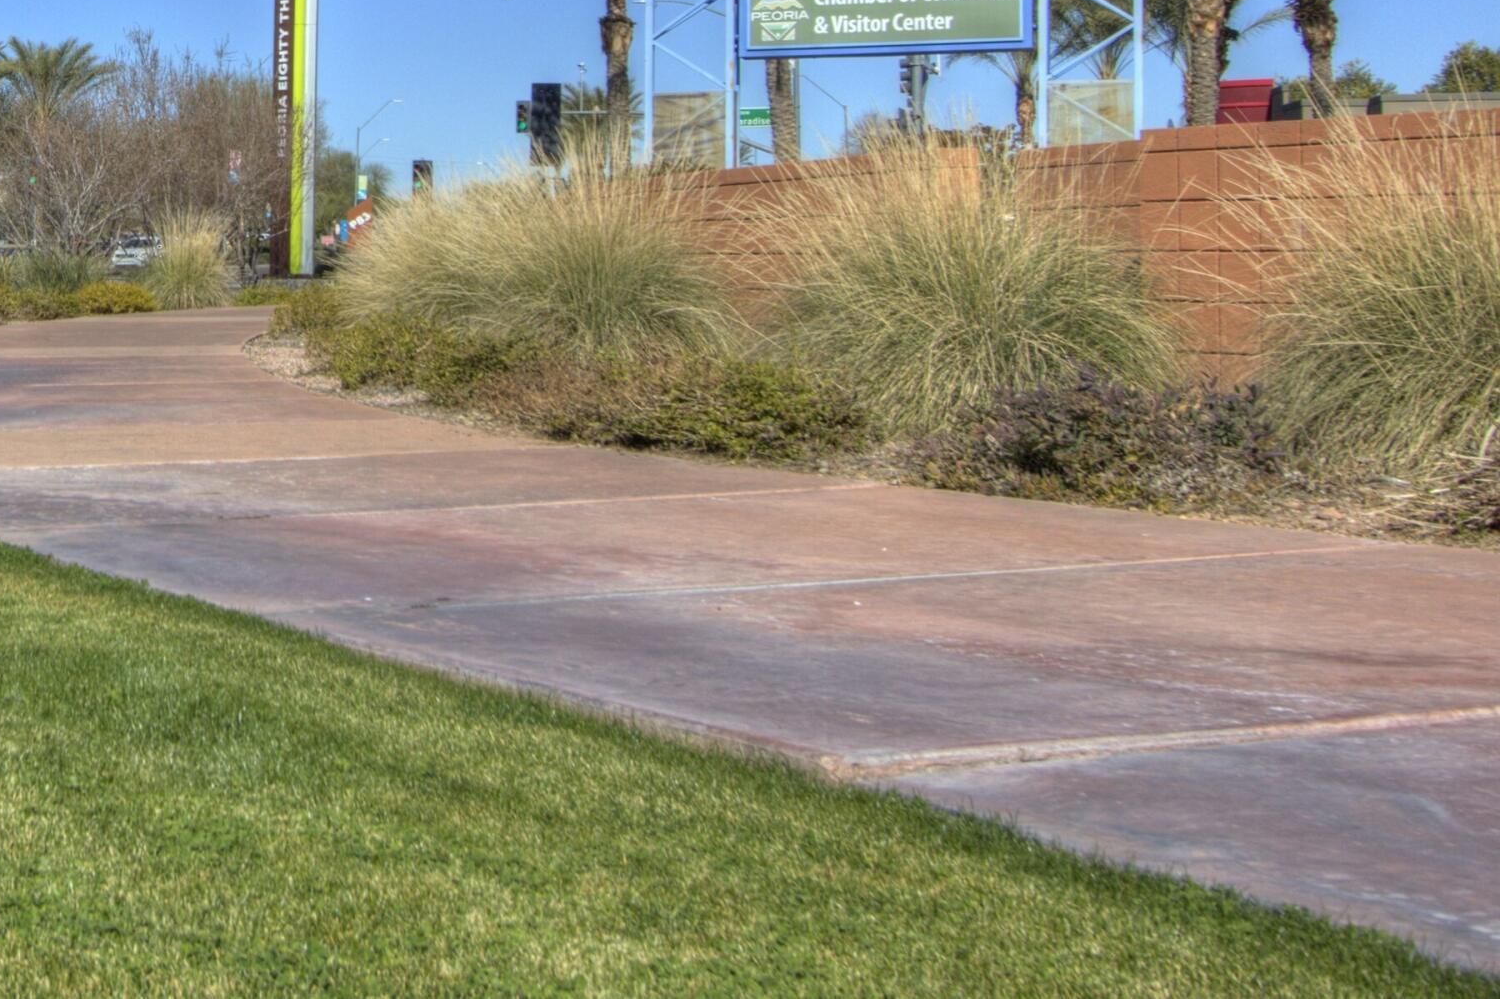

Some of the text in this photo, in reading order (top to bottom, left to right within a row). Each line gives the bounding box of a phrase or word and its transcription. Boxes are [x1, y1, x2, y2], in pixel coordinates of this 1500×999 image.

[751, 9, 810, 22] PEORIA
[814, 13, 954, 34] & Visitor Center
[278, 28, 290, 91] EIGHTY
[739, 117, 771, 125] aradise
